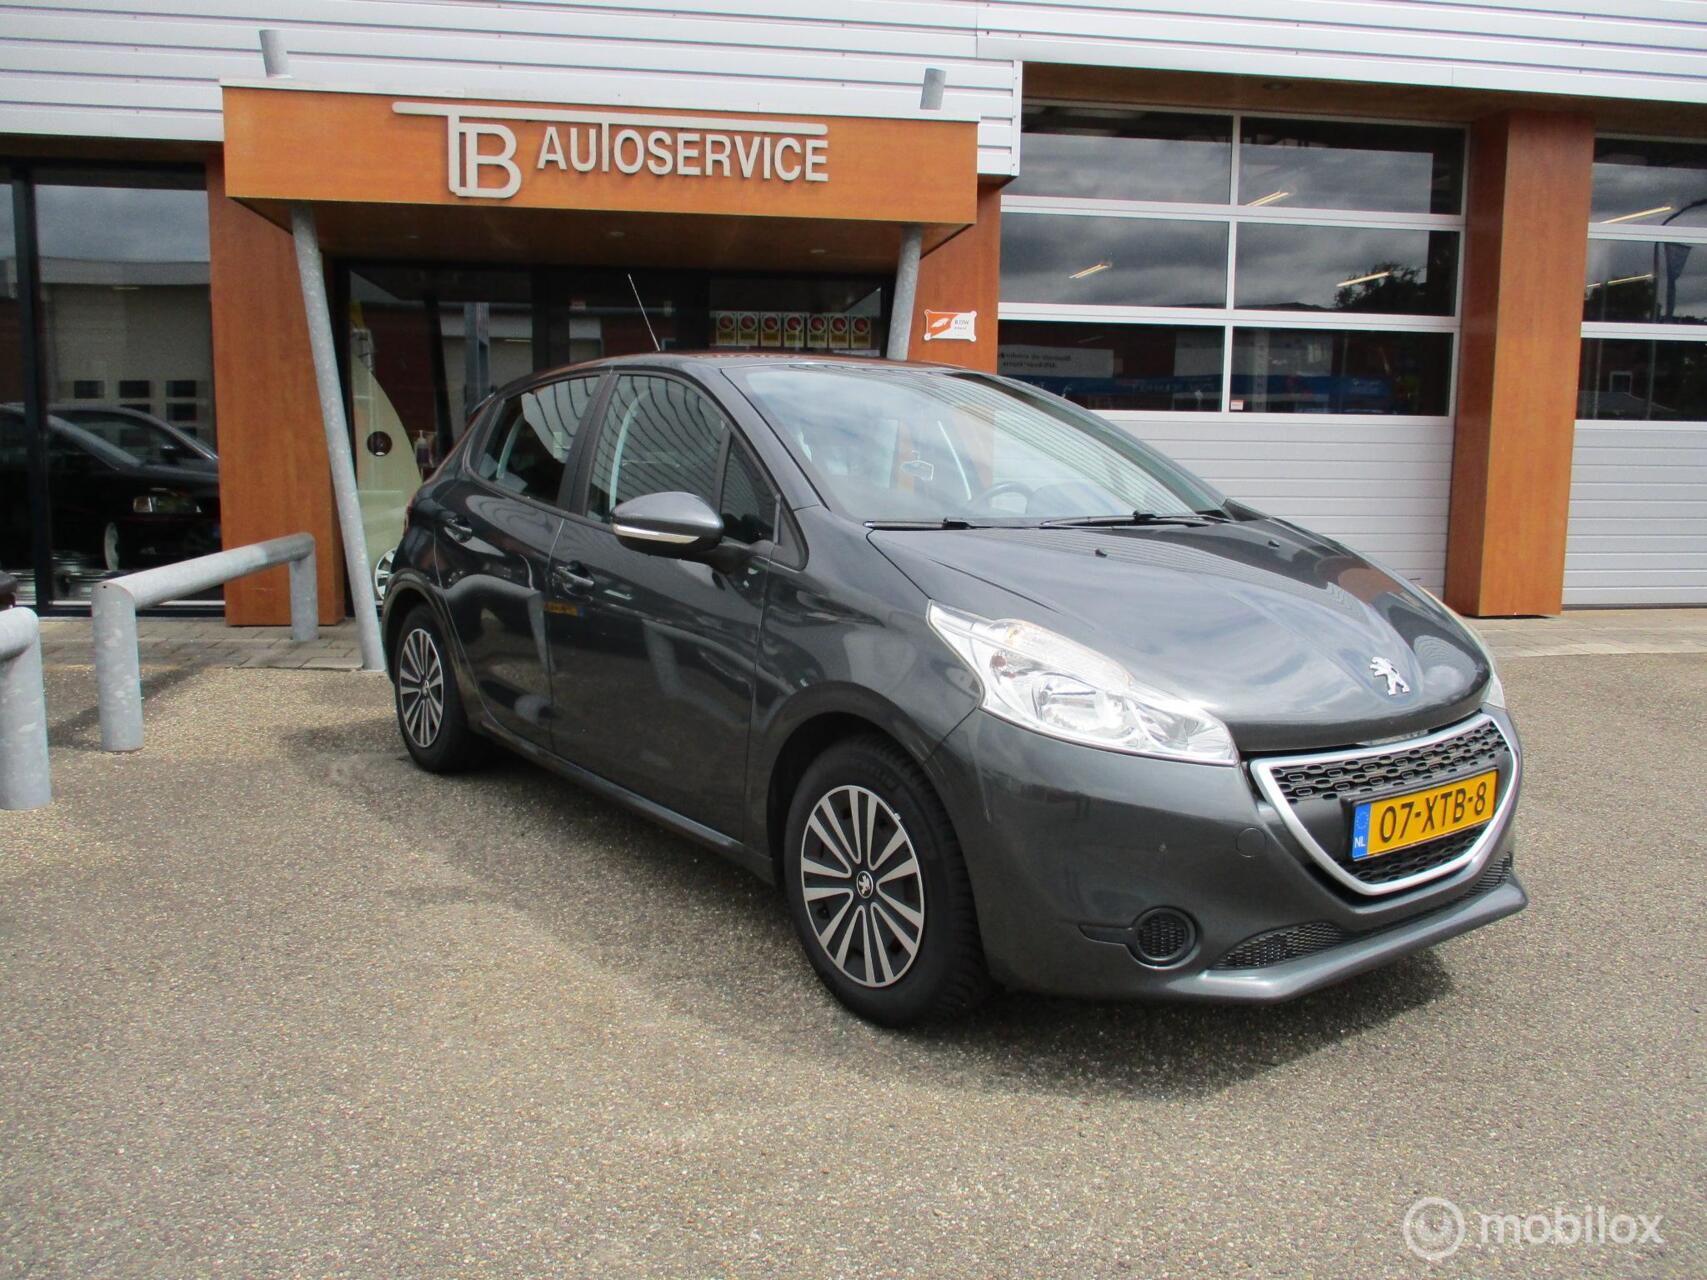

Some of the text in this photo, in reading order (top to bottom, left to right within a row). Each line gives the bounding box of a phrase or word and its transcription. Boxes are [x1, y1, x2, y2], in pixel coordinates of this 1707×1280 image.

[392, 101, 829, 198] TB AUTOSERVICE
[1354, 836, 1366, 848] NL
[1380, 781, 1487, 843] 07-XTB-8
